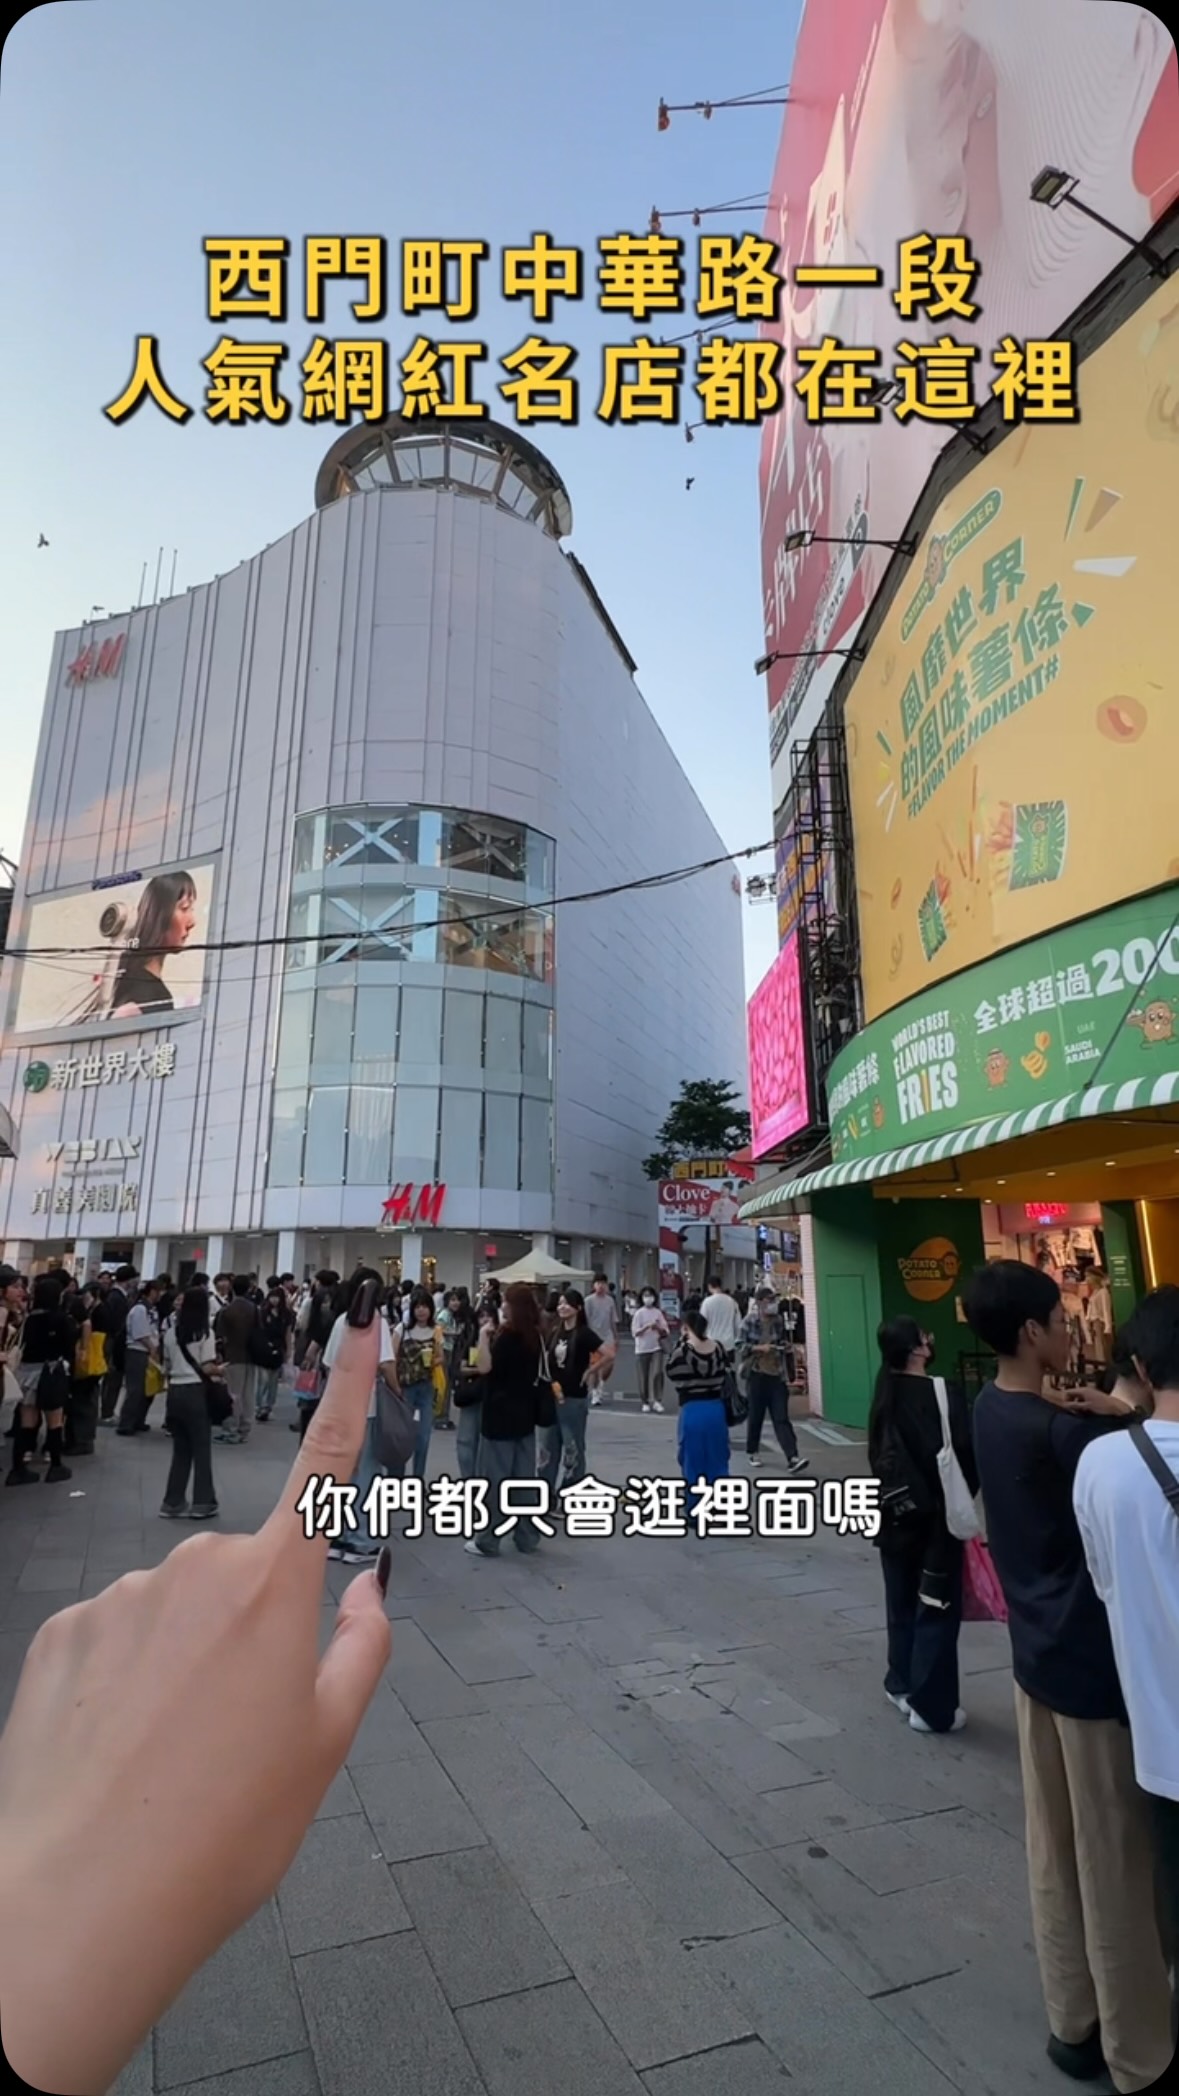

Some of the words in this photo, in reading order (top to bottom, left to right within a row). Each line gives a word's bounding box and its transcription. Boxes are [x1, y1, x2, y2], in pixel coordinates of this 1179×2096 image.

[943, 500, 996, 563] CORNER
[901, 581, 1069, 801] 的風味薯條
[947, 728, 966, 772] THE
[925, 1009, 950, 1033] BEST
[51, 1042, 176, 1091] 新世界大樓
[893, 1031, 956, 1081] FLAVORED
[1066, 1048, 1101, 1065] ARABIA
[897, 1060, 959, 1125] FRIES
[662, 1183, 711, 1202] Clove
[897, 1257, 938, 1270] POTATO
